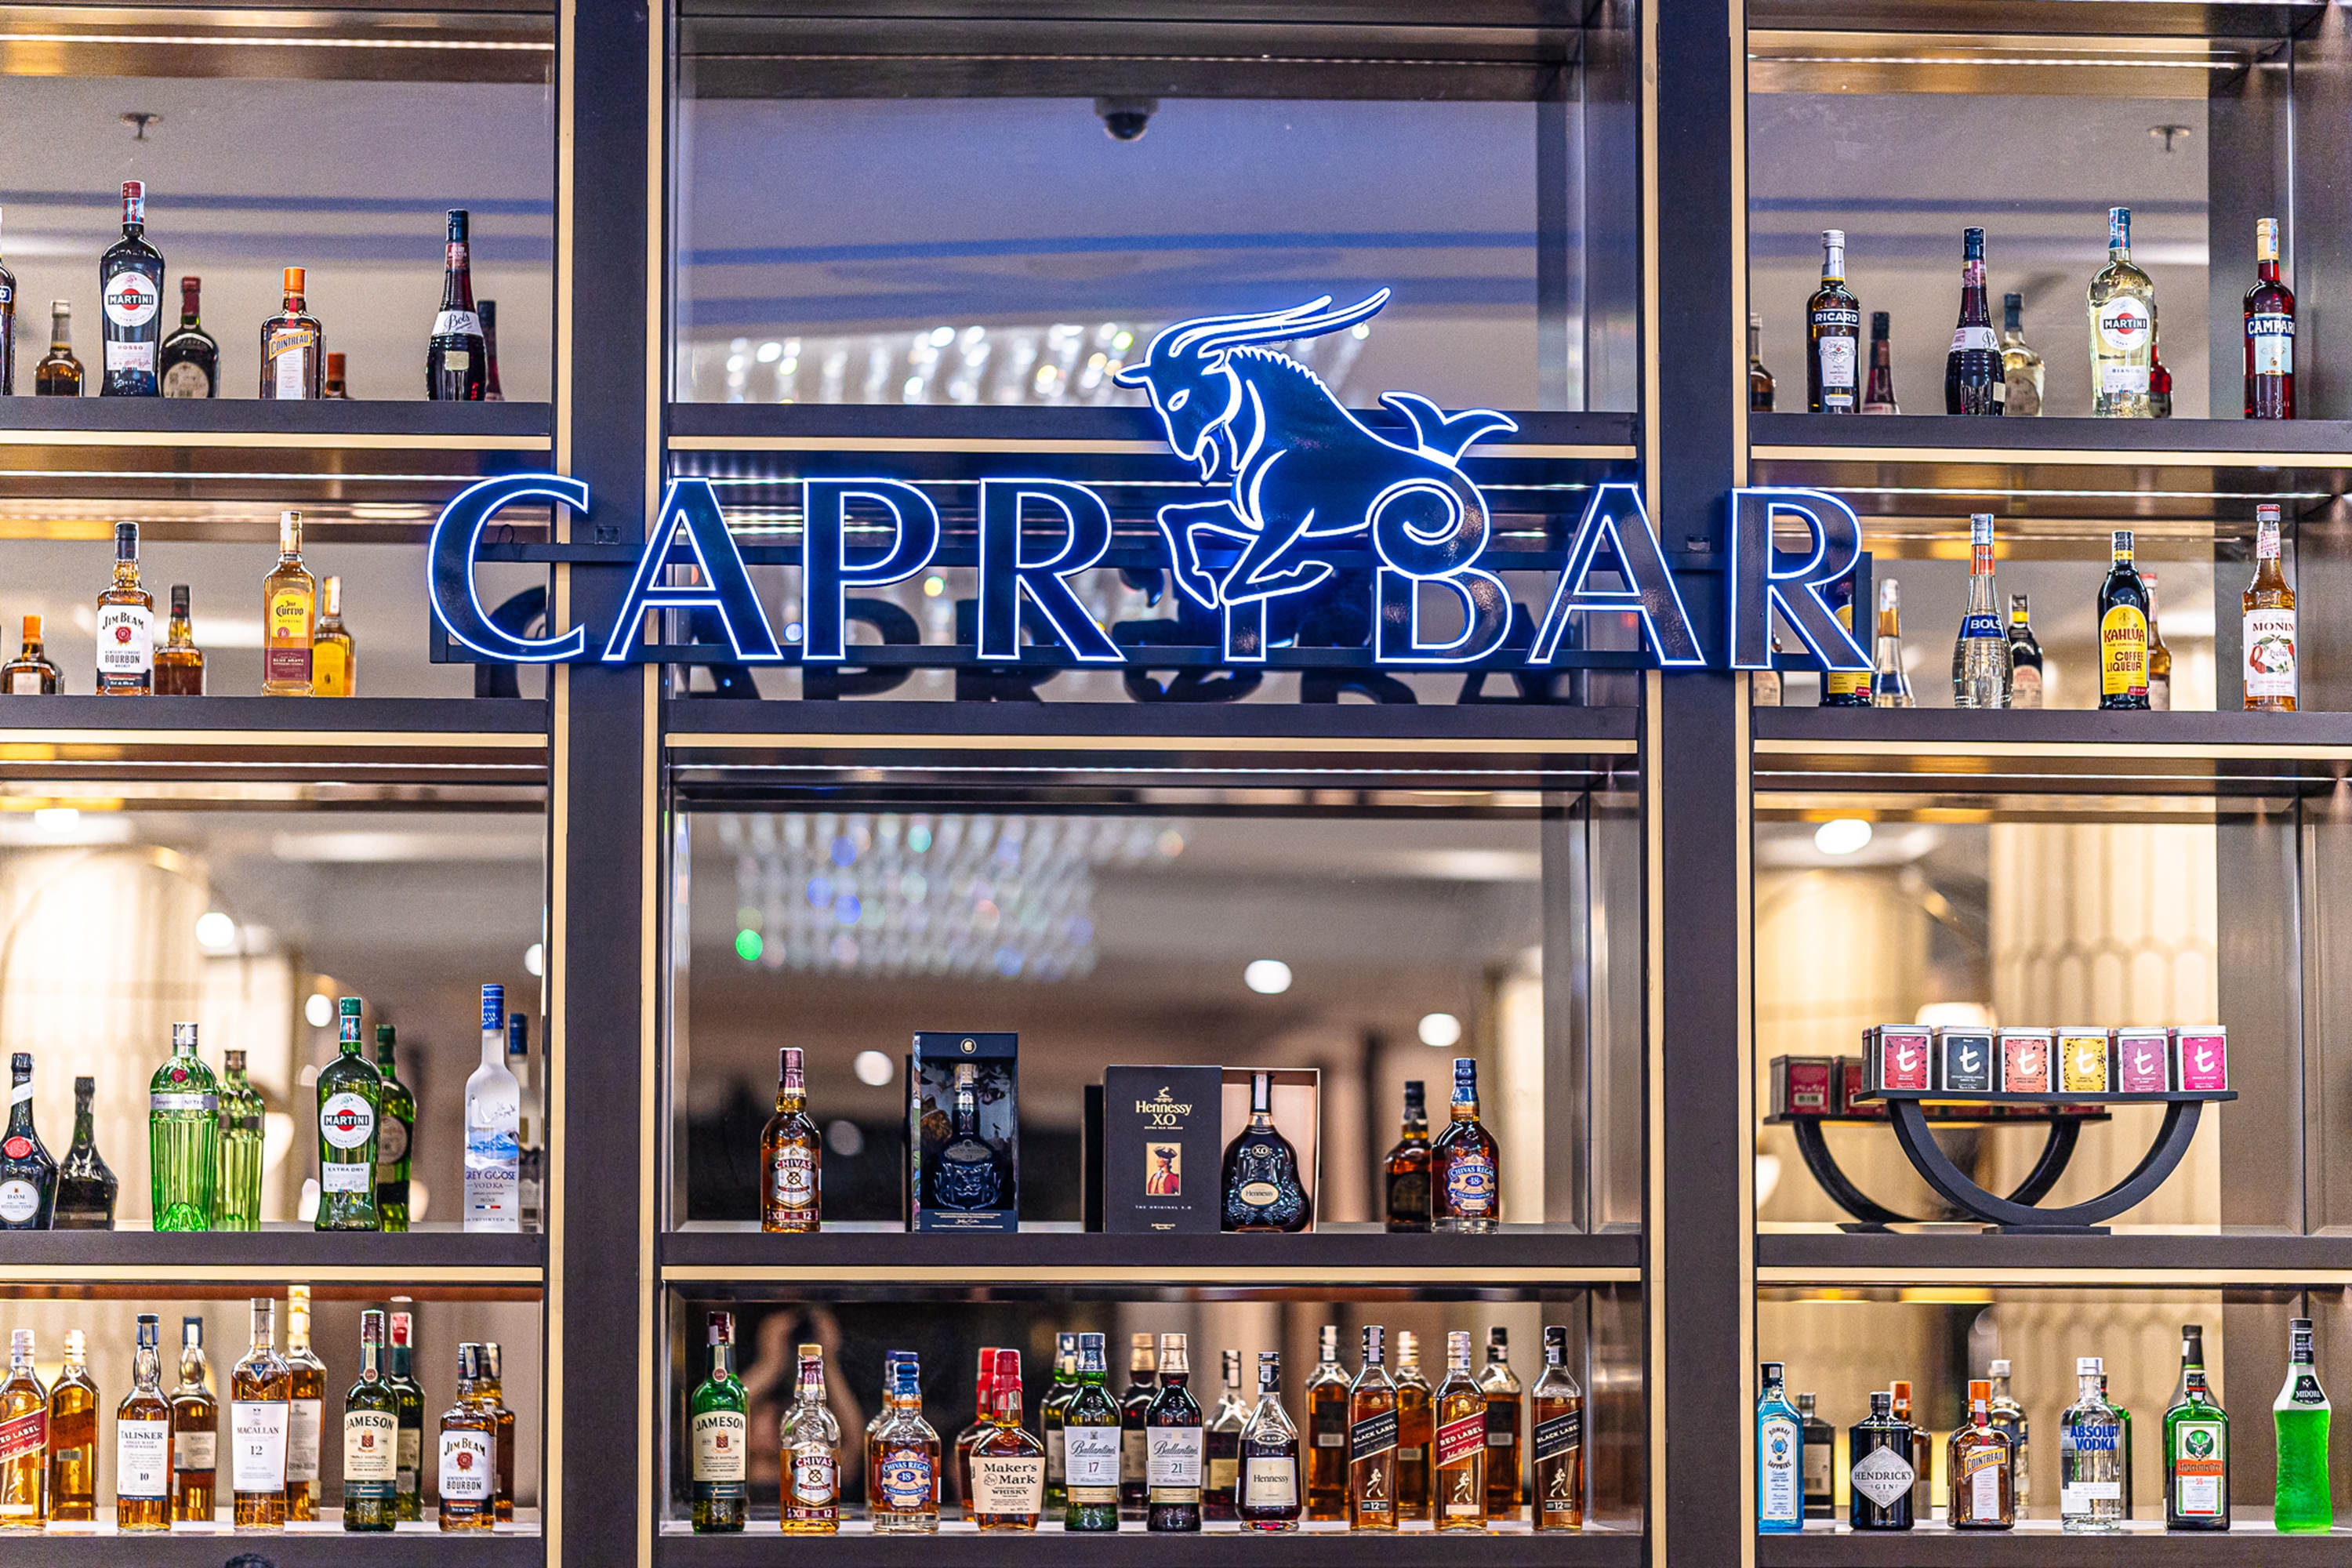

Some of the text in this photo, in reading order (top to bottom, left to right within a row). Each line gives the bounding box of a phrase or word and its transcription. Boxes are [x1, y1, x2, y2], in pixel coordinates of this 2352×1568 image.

[109, 295, 153, 304] MARTINI
[443, 312, 472, 332] Bols
[1815, 313, 1857, 322] RICARD
[2104, 319, 2147, 328] MARTINI
[270, 334, 309, 355] COINTREAU
[1374, 481, 1878, 672] BAR
[276, 605, 304, 618] Cuervo
[102, 612, 144, 630] JIM BEAM
[1970, 619, 2003, 630] BOLS
[2253, 622, 2294, 632] MONIN
[105, 655, 140, 664] BOURBON
[2114, 652, 2143, 662] COFFEE
[2107, 662, 2142, 673] LIQUEUR
[1896, 1044, 1917, 1073] t
[1959, 1045, 1980, 1073] t
[2016, 1047, 2038, 1075] t
[2074, 1047, 2096, 1074] t
[2134, 1047, 2154, 1076] t
[2194, 1045, 2215, 1073] t
[1135, 1100, 1192, 1116] Hennessy
[325, 1116, 368, 1125] MARTINI
[775, 1160, 812, 1170] CHIVAS
[485, 1171, 515, 1181] GOOSE
[1450, 1166, 1494, 1177] CHIVAS REGAL
[1471, 1177, 1479, 1185] 18
[346, 1416, 394, 1431] JAMESON
[695, 1416, 744, 1432] JAMESON
[0, 1425, 41, 1443] ED LABEL
[121, 1431, 163, 1439] TALISKER
[1352, 1424, 1398, 1443] BLACK LABEL
[1439, 1426, 1484, 1446] RED LABEL
[1537, 1424, 1581, 1443] BLACK LABEL
[1769, 1427, 1791, 1438] BOMBAY
[2071, 1425, 2118, 1438] ABSOLUT
[444, 1437, 486, 1457] JIM BEAM
[2075, 1438, 2115, 1450] VODKA
[251, 1446, 263, 1455] 12
[796, 1458, 833, 1468] CHIVAS
[883, 1461, 931, 1472] CHIVAS REGAL
[983, 1463, 1037, 1472] Maker's
[1088, 1461, 1099, 1472] 17
[1767, 1460, 1792, 1469] SAPPHIRE
[1966, 1452, 2003, 1472] COINTREAU
[1171, 1463, 1182, 1474] 21
[902, 1472, 911, 1482] 18
[999, 1474, 1037, 1484] Mark
[1254, 1474, 1289, 1483] Hennessy
[1854, 1471, 1912, 1480] HENDRICK'S
[447, 1481, 481, 1490] BOURBON
